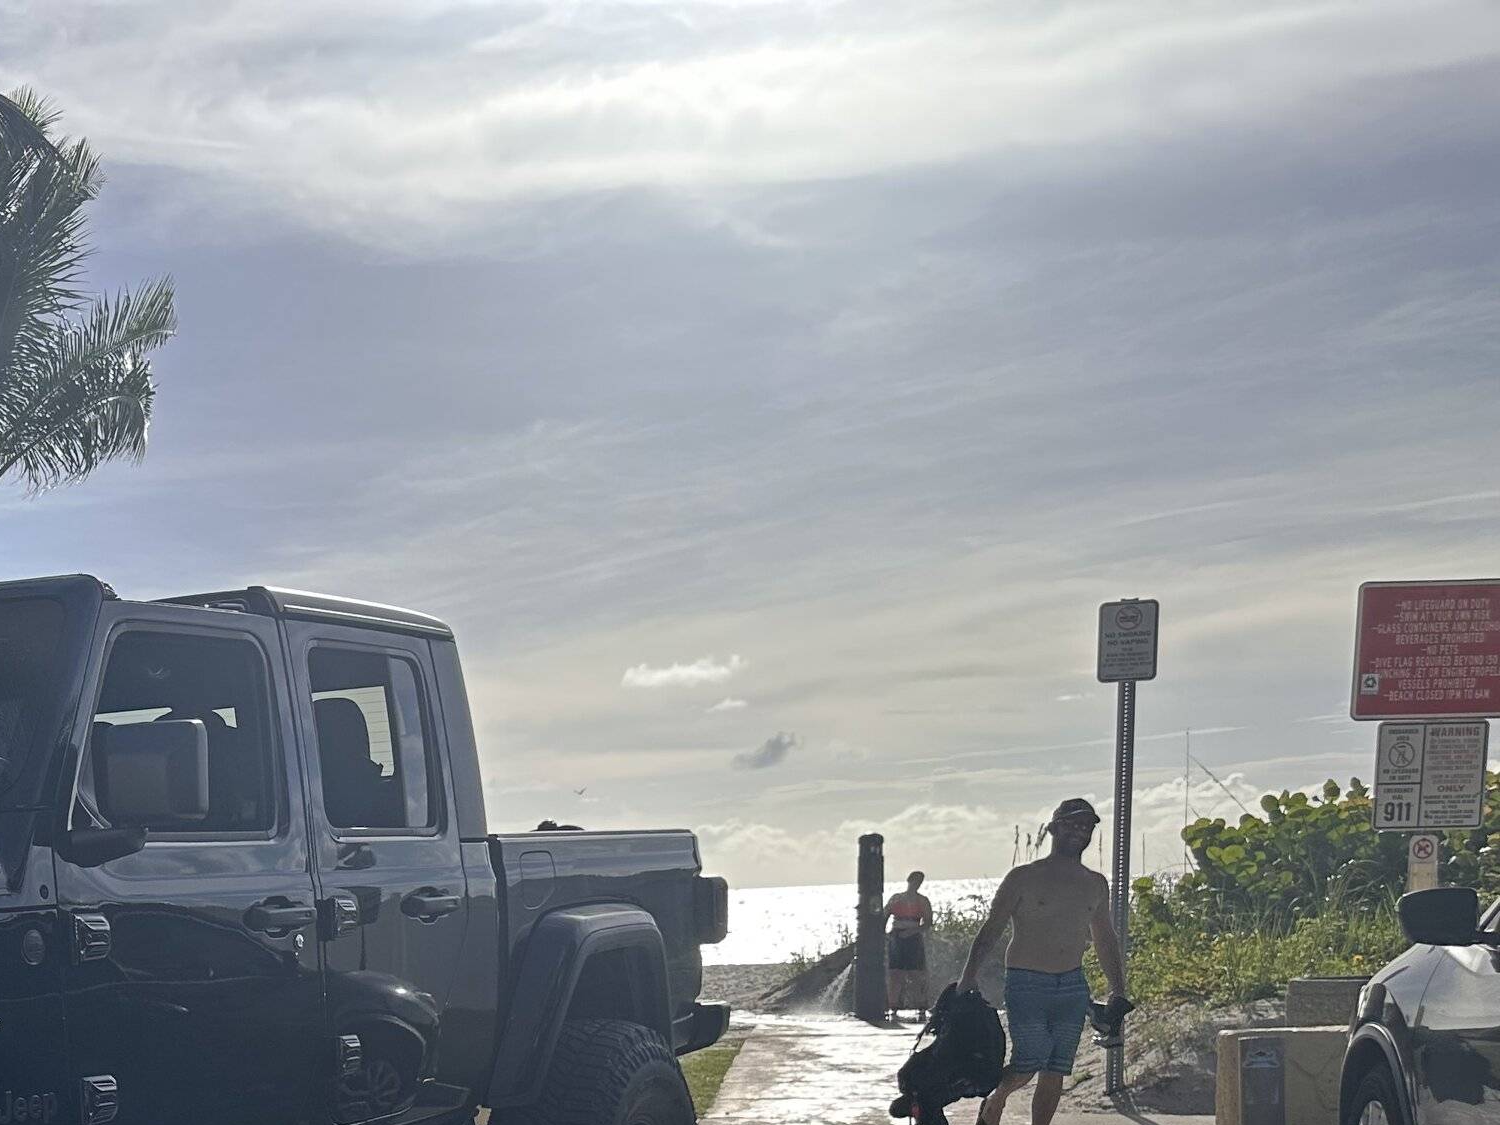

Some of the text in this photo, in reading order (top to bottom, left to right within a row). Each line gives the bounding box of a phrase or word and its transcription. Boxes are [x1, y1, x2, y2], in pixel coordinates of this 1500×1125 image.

[1414, 600, 1455, 610] LIFEGUARD
[1458, 599, 1468, 609] ON
[1470, 598, 1490, 608] DUTY
[1420, 611, 1431, 621] AT
[1433, 611, 1452, 620] YOUR
[1455, 610, 1471, 620] OWN
[1473, 610, 1490, 619] RISK
[1404, 622, 1449, 633] CONTAINERS
[1452, 622, 1467, 631] AND
[1395, 633, 1485, 645] BEVERAGES PROHIBITED
[1439, 645, 1458, 654] PETS
[1394, 657, 1413, 668] FLAG
[1416, 656, 1451, 667] REQUIRED
[1454, 656, 1483, 665] BEYOND
[1413, 668, 1426, 678] JET
[1429, 668, 1439, 677] OR
[1442, 667, 1468, 677] ENGINE
[1398, 678, 1476, 689] VESSELS PROHIBITED
[1416, 690, 1444, 700] CLOSED
[1463, 690, 1473, 699] TO
[1430, 727, 1480, 737] WARNING
[1384, 802, 1412, 822] 911
